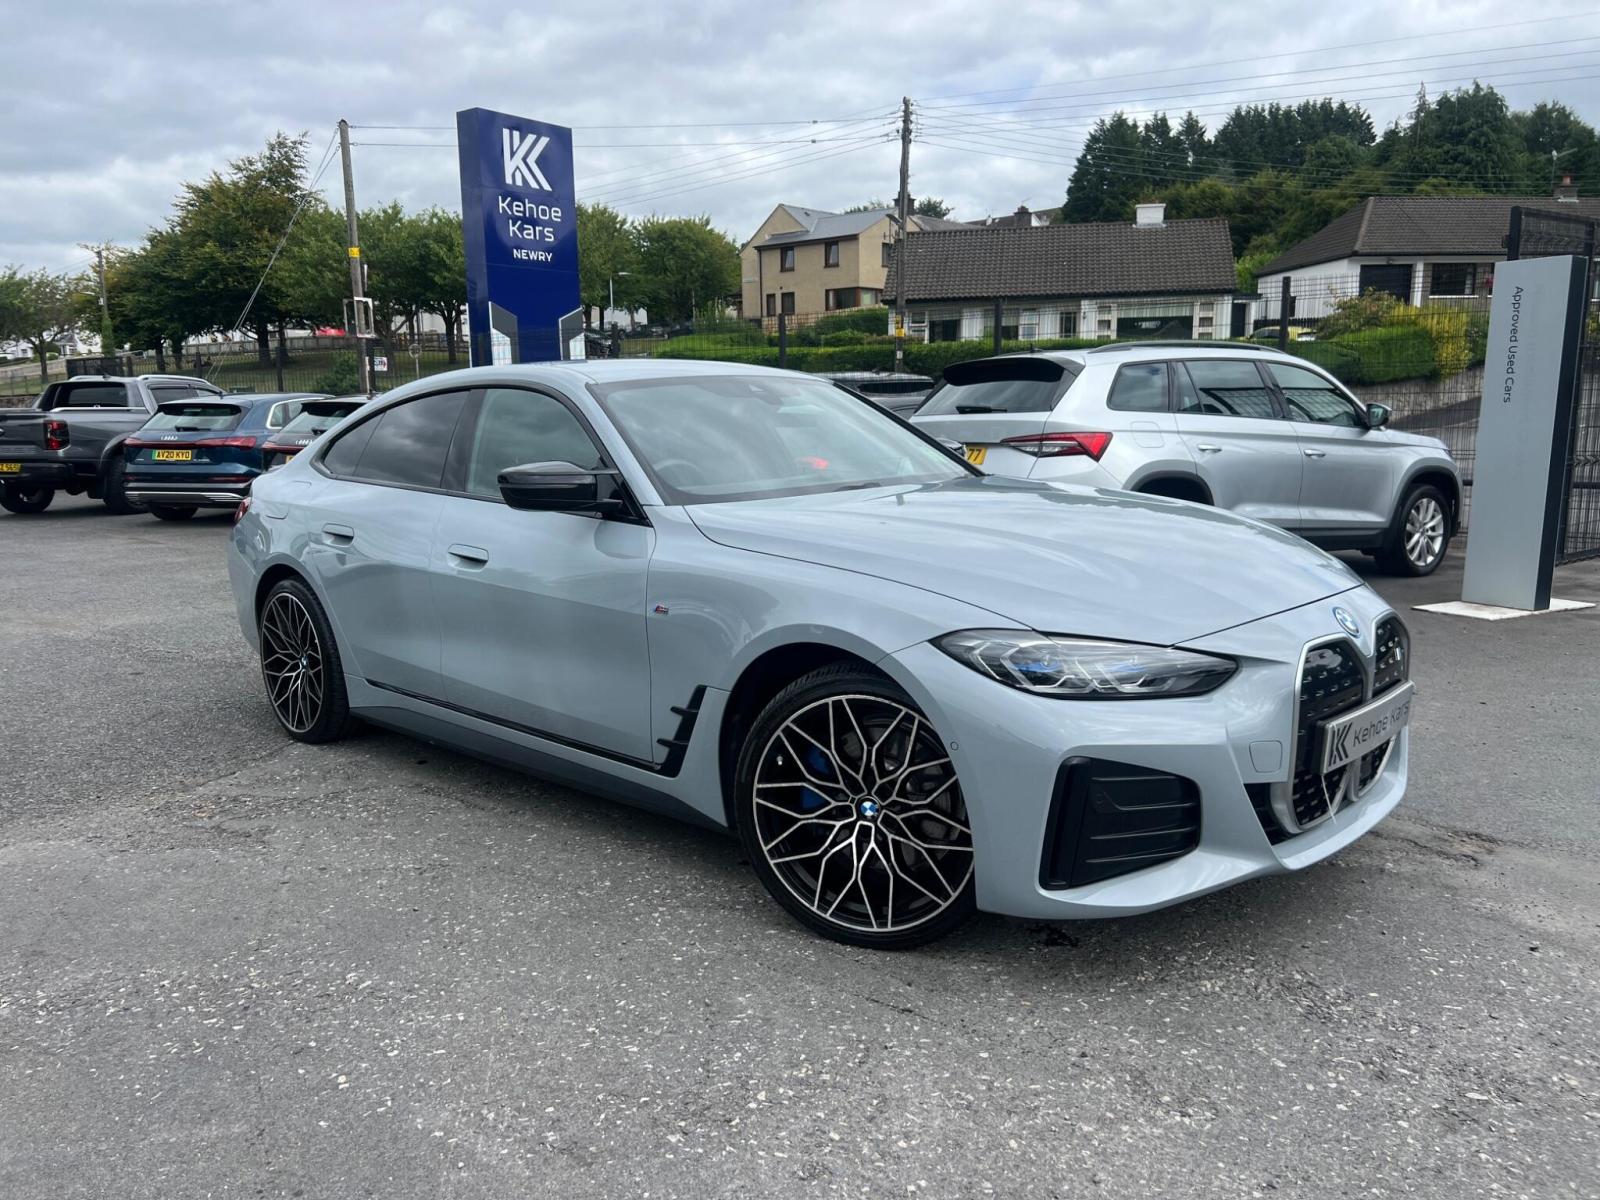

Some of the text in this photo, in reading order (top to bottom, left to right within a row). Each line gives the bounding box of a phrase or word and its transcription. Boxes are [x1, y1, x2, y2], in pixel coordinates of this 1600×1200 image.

[498, 195, 562, 222] Kehoe
[508, 219, 555, 242] Kars
[513, 248, 553, 262] NEWRY
[1503, 286, 1524, 403] Approved Used Cars
[156, 450, 175, 460] AV20
[1352, 716, 1388, 747] Kehoe
